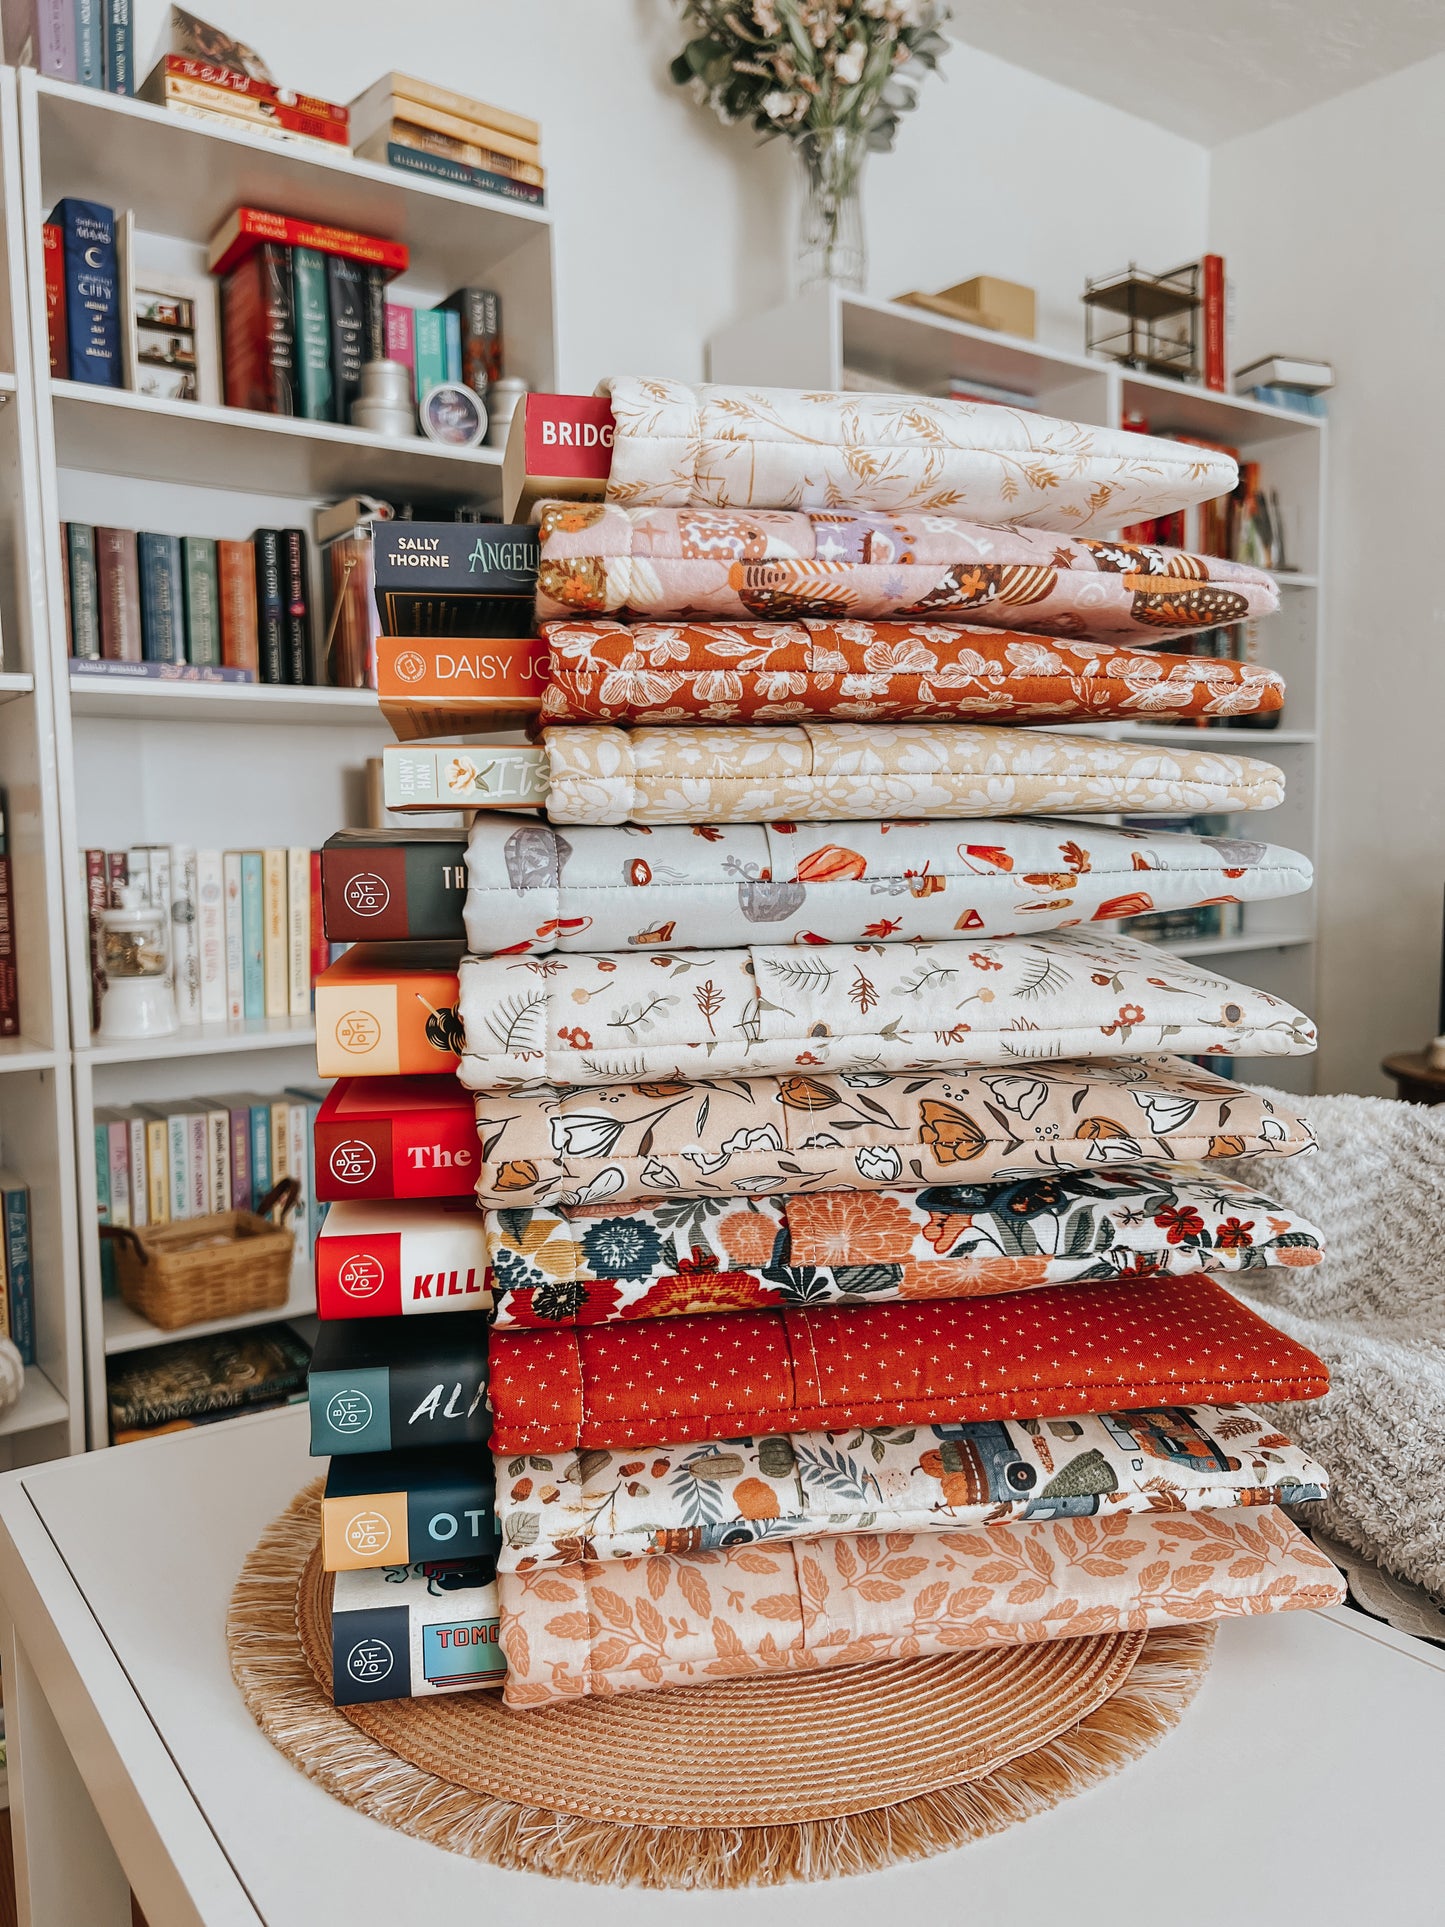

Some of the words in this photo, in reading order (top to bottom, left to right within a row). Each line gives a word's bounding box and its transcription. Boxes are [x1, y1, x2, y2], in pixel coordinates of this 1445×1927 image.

[542, 420, 614, 448] BRIDG
[397, 537, 440, 551] SALLY
[388, 553, 450, 568] THORNE
[435, 654, 513, 680] DAISY
[400, 758, 415, 796] JENNY
[416, 764, 431, 789] HAN
[483, 750, 550, 798] It's
[442, 866, 465, 889] TH
[407, 1144, 472, 1169] The
